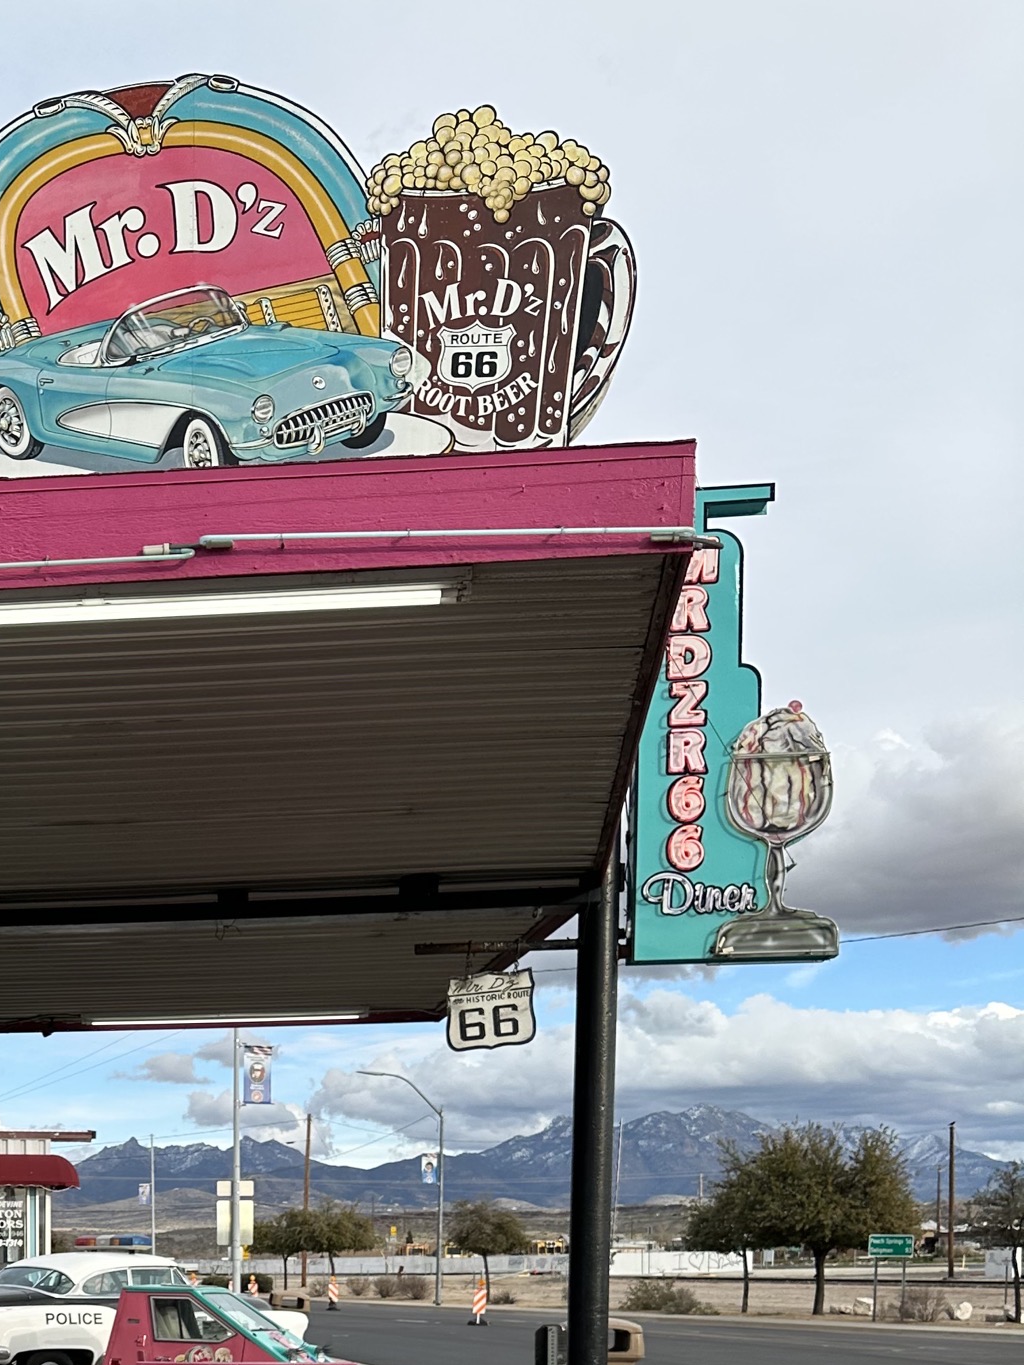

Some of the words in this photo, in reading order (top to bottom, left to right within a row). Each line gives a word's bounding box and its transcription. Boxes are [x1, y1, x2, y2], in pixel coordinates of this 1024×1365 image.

[21, 201, 161, 315] Mr.
[450, 333, 503, 345] ROUTE
[451, 352, 498, 378] 66
[415, 378, 472, 416] ROOT
[477, 372, 539, 416] BEER
[641, 872, 757, 915] Diner
[466, 993, 505, 1004] HISTORIC
[507, 990, 530, 999] ROUTE
[459, 1004, 519, 1041] 66
[45, 1312, 103, 1325] POLICE
